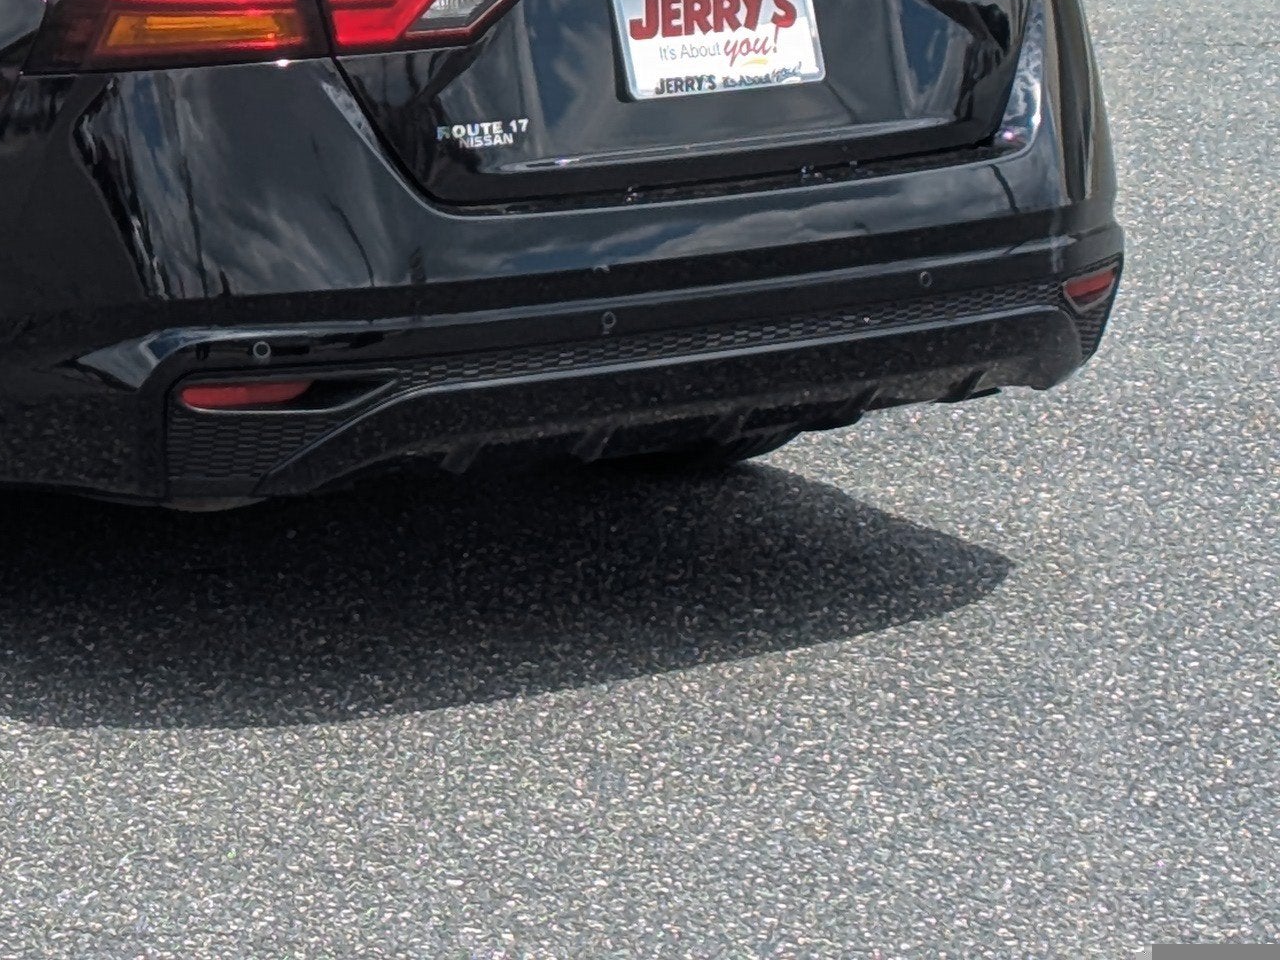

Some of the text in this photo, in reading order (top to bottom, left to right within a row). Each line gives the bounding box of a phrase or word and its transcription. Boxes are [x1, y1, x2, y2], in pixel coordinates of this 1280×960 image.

[659, 26, 778, 67] It's About you!
[655, 74, 716, 95] JERRY'S
[436, 118, 529, 141] ROUTE 17
[459, 133, 514, 148] NISSAN
